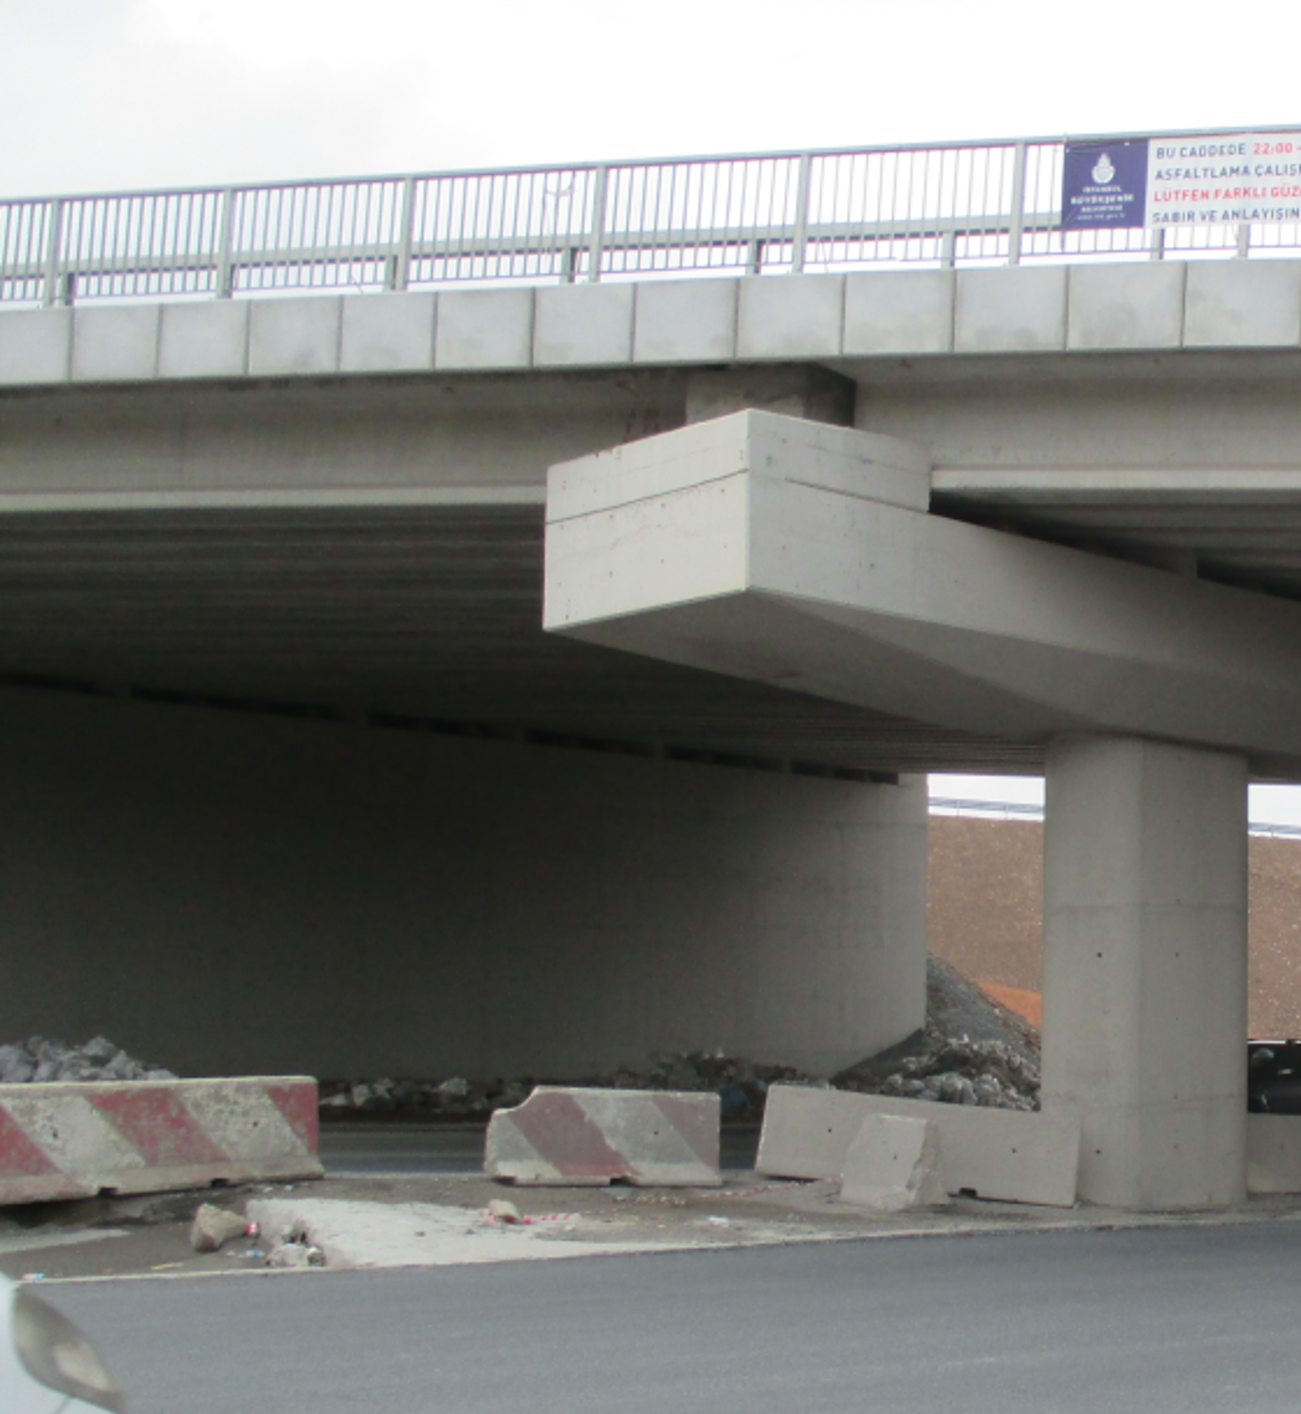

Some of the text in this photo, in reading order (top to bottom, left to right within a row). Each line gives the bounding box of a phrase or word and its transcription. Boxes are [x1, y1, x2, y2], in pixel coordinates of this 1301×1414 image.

[1156, 146, 1177, 159] BU
[1179, 142, 1246, 158] CADDEDE
[1252, 141, 1294, 155] 22:00
[1155, 164, 1251, 180] ASFALTLAMA
[1153, 187, 1211, 202] LÜTFEN
[1214, 186, 1267, 200] FARKLI
[1152, 210, 1196, 224] SABIR
[1199, 209, 1218, 222] VE
